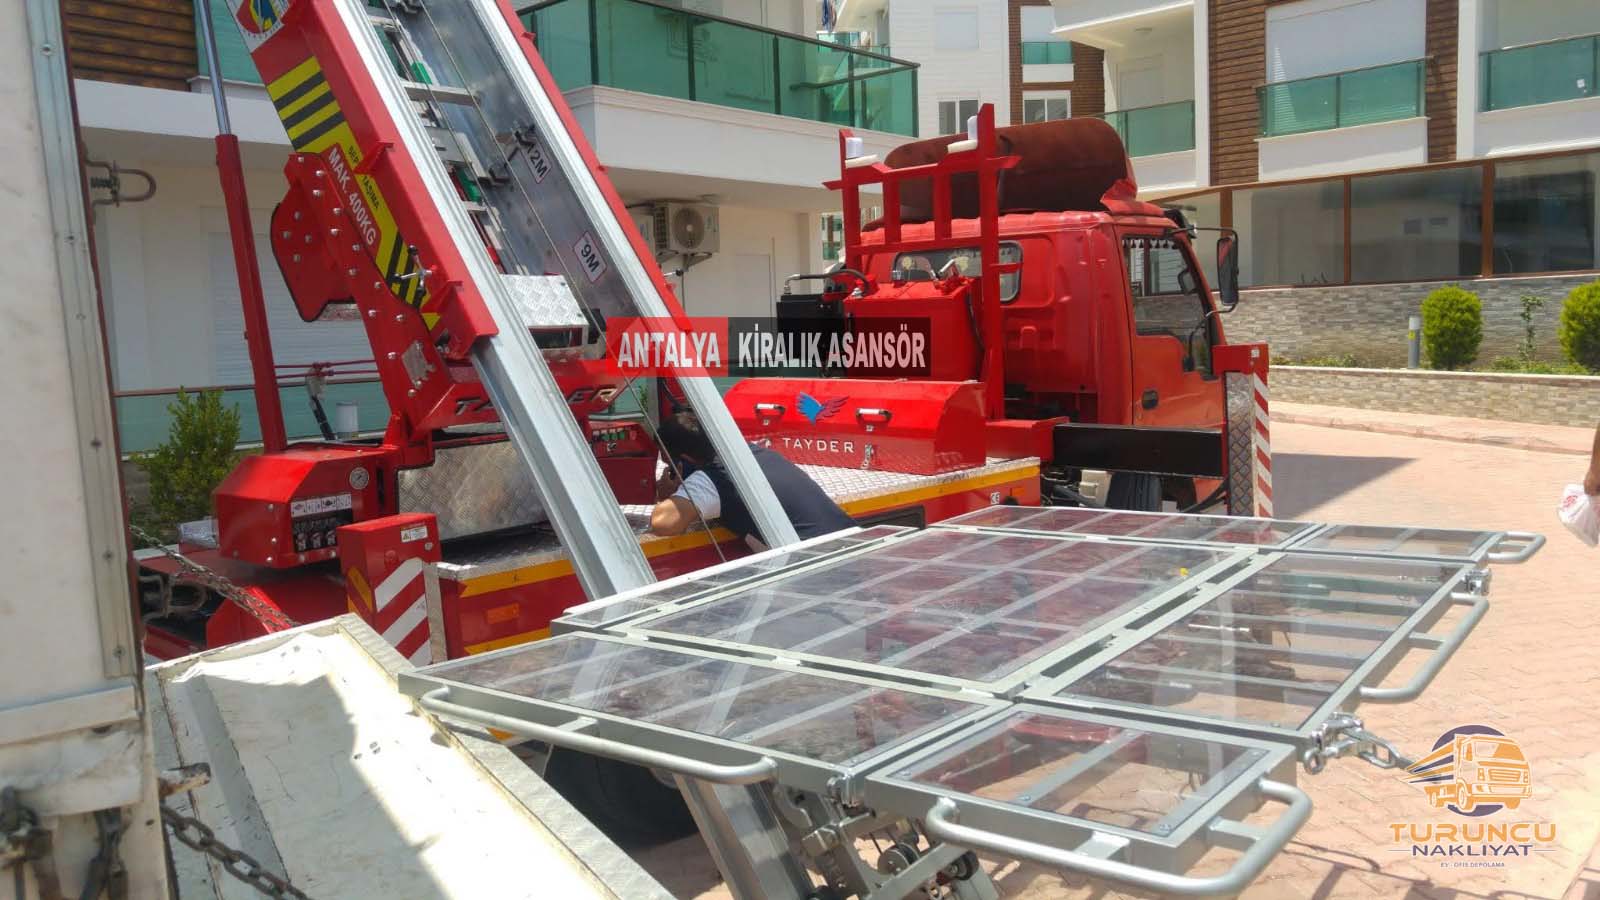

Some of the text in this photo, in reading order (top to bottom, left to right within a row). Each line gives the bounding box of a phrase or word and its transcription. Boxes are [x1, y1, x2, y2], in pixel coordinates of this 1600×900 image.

[328, 147, 377, 246] MAK. 400KG
[580, 243, 600, 273] 9M
[782, 437, 855, 454] TAYDER
